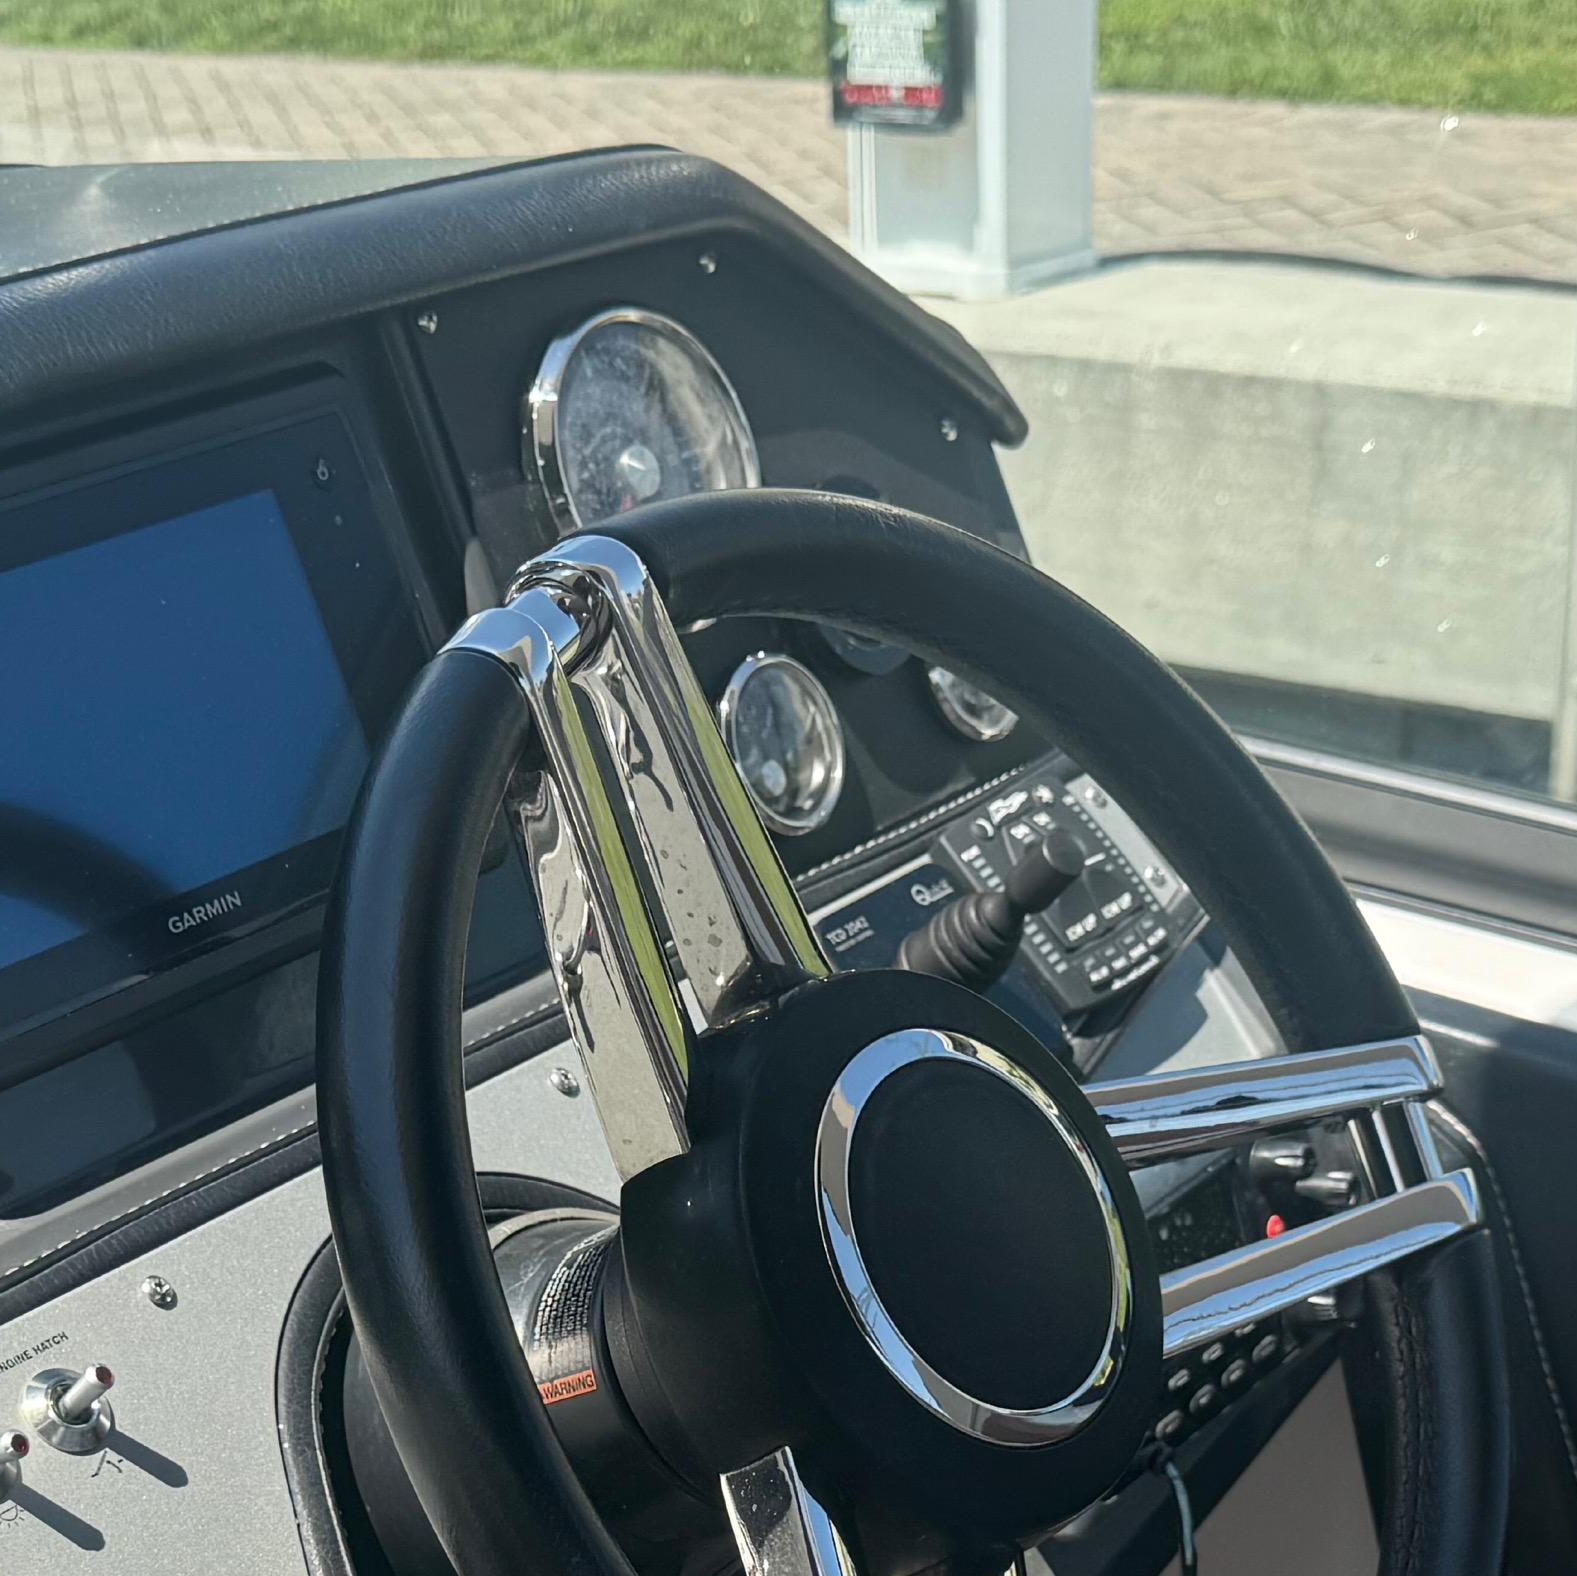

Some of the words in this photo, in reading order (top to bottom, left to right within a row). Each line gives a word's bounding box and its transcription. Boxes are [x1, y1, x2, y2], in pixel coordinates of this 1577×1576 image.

[168, 890, 243, 933] GARMIN
[30, 1331, 69, 1355] HATCH
[543, 1374, 595, 1399] WARNING
